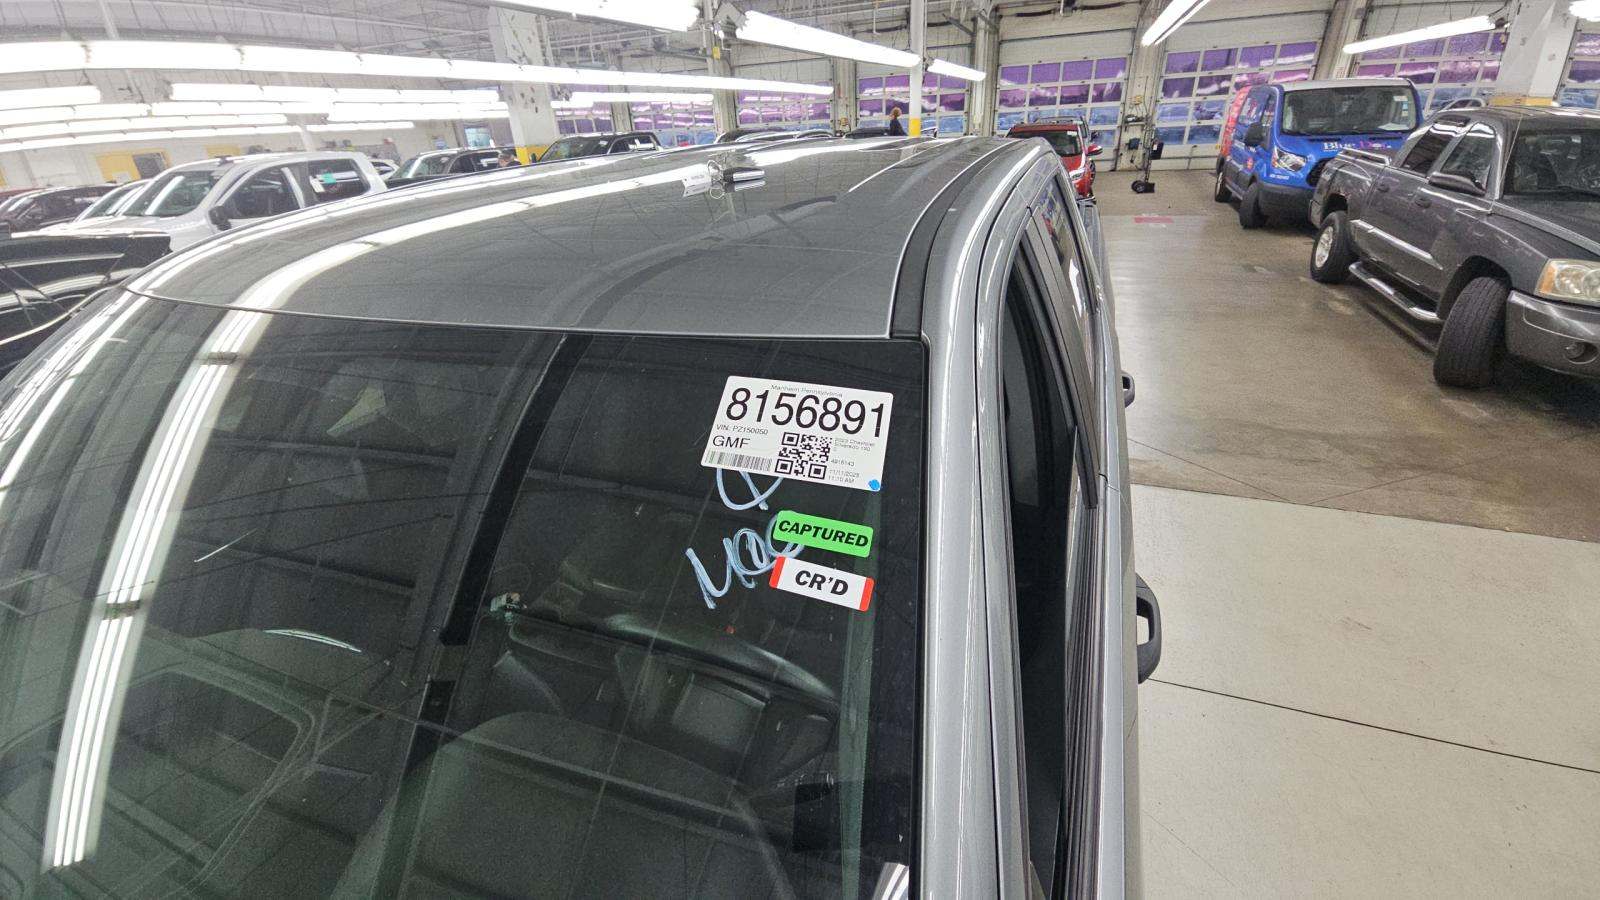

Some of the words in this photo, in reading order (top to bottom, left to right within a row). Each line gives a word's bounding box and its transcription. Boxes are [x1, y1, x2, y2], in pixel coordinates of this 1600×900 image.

[725, 387, 885, 438] 8156891
[712, 435, 751, 449] GMF
[778, 519, 869, 548] CAPTURED
[794, 570, 849, 596] CR'D
